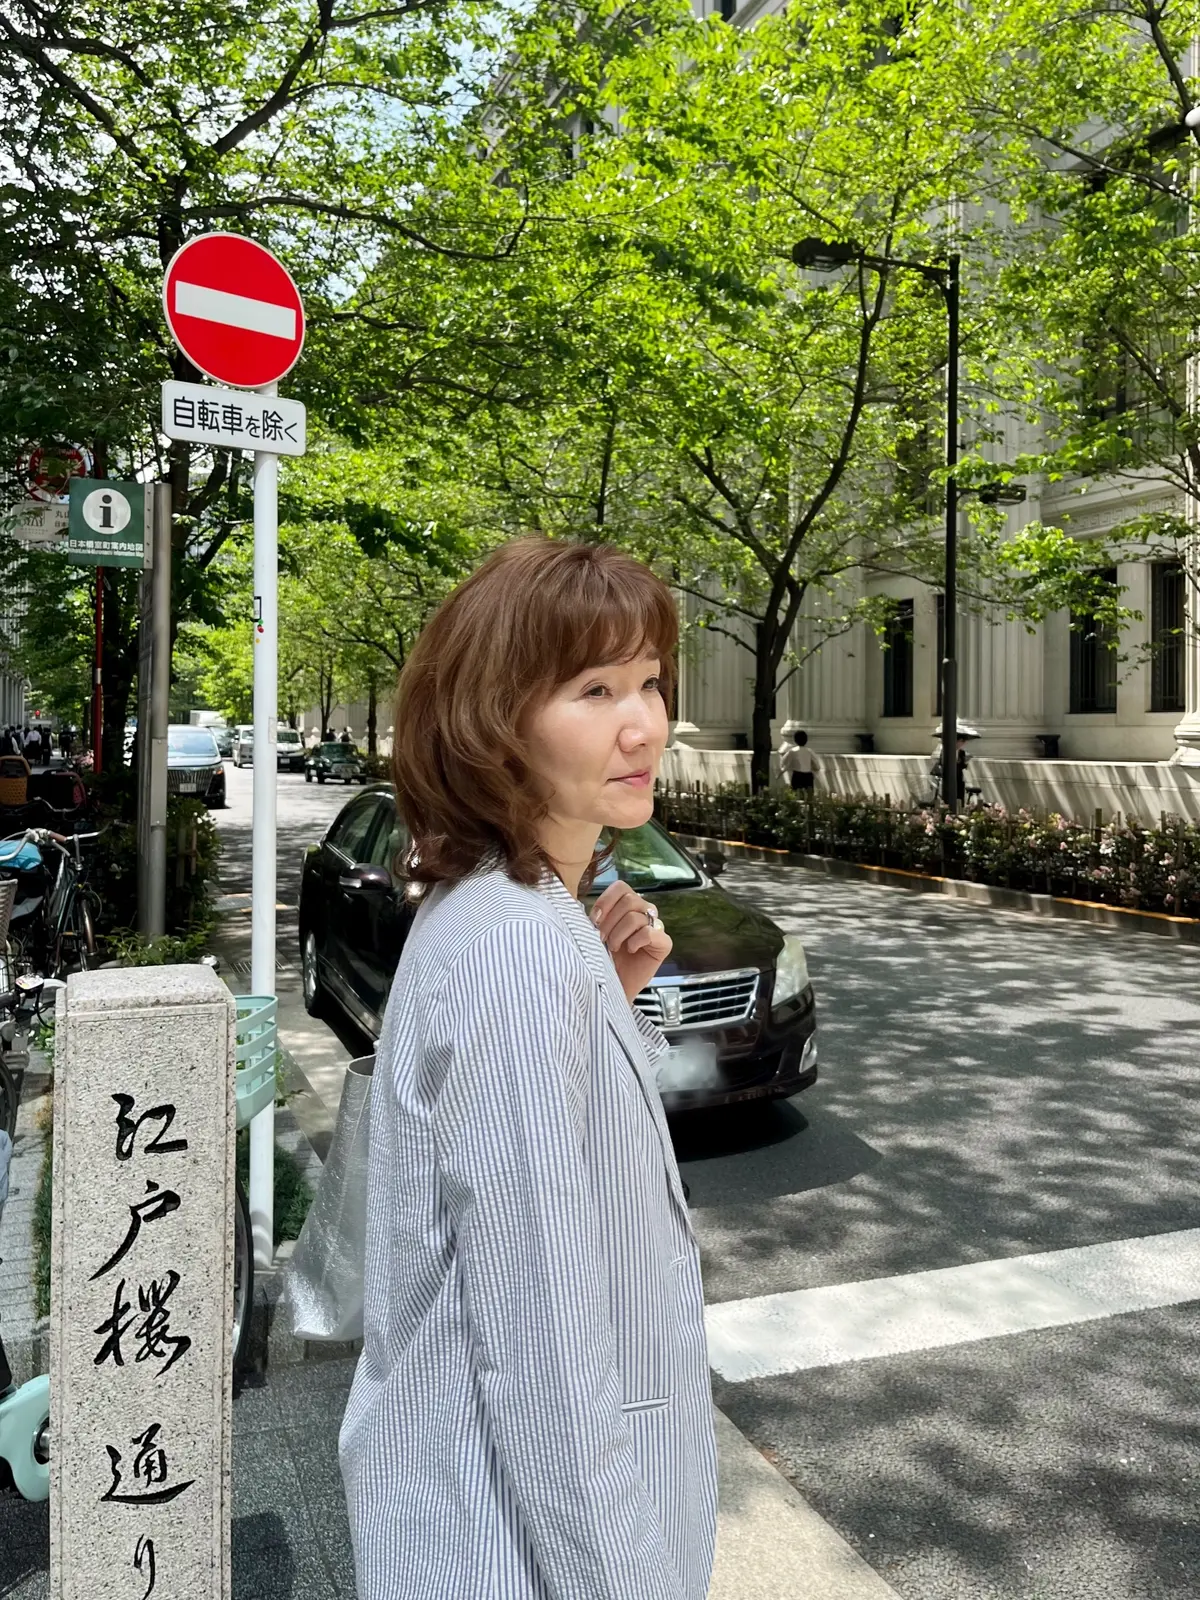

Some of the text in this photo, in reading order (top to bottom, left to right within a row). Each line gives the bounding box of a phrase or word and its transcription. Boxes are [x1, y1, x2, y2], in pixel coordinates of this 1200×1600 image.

[173, 395, 298, 443] 自転車を除く
